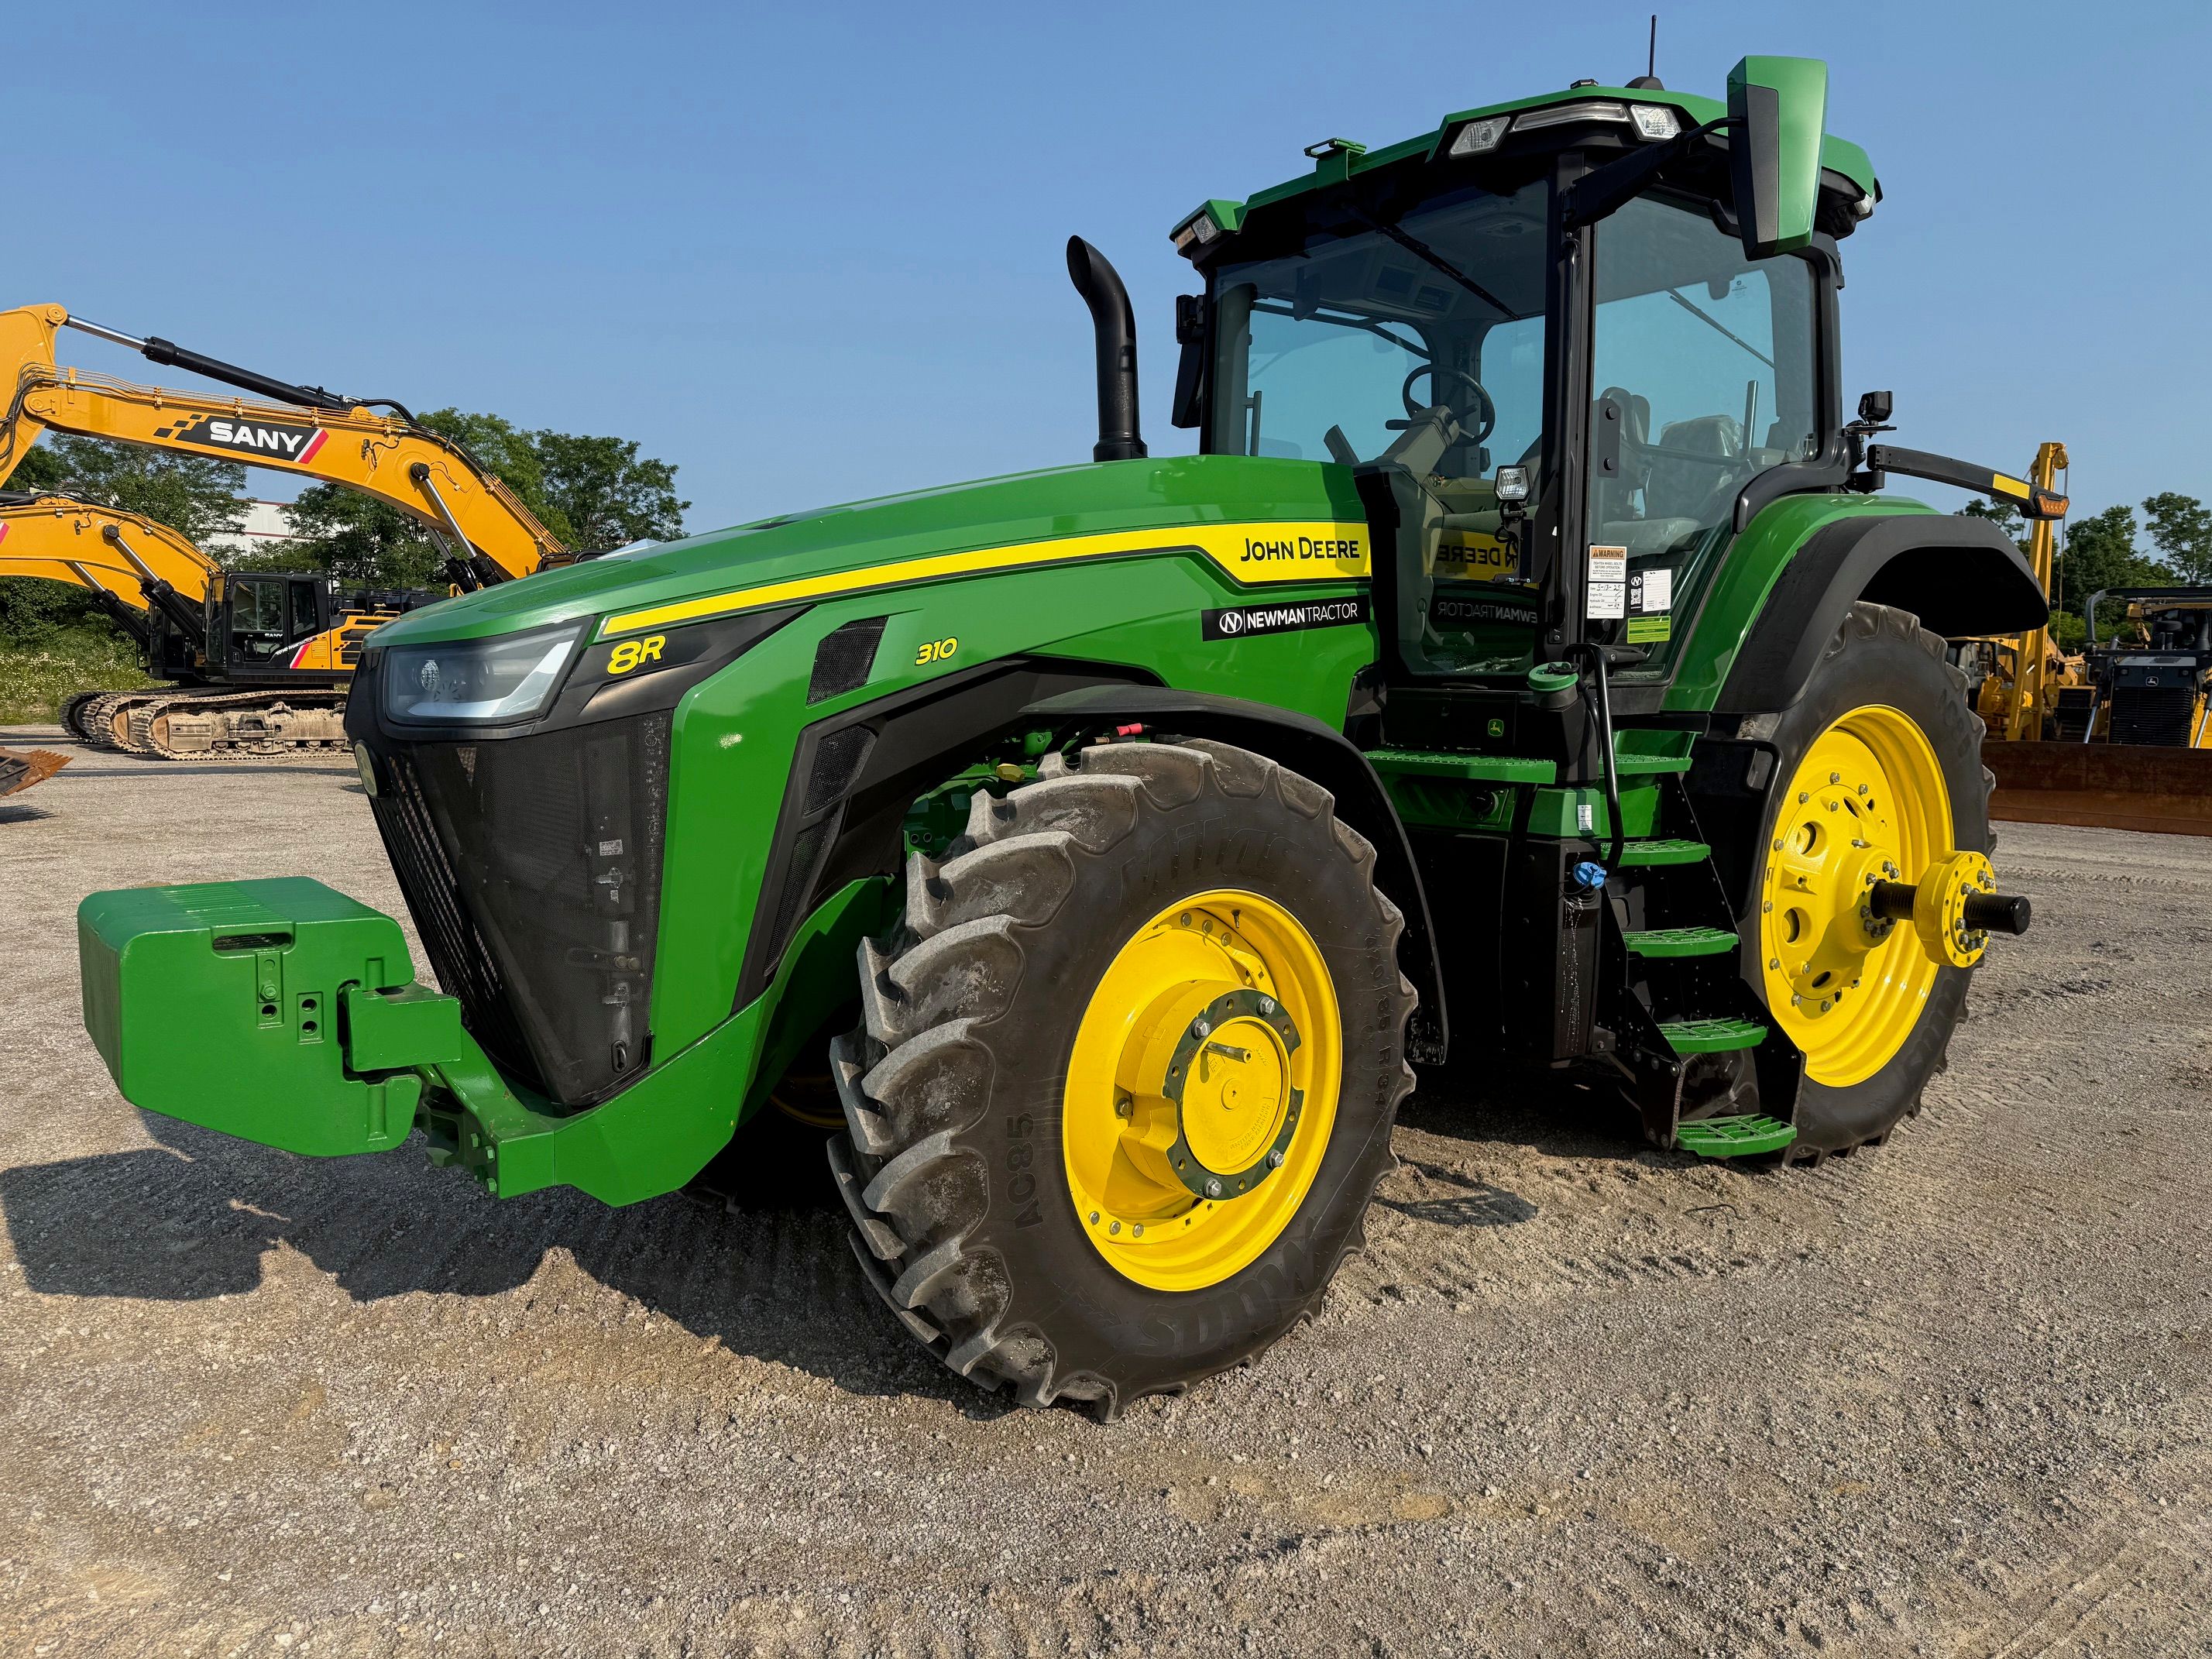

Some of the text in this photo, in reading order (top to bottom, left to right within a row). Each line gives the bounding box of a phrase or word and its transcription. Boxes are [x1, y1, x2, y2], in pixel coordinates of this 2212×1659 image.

[210, 421, 303, 452] SANY
[1241, 537, 1360, 562] JOHN DEERE
[1599, 549, 1623, 558] WARNING
[607, 635, 667, 675] 8R
[915, 637, 958, 666] 310
[1006, 1111, 1045, 1230] AC85
